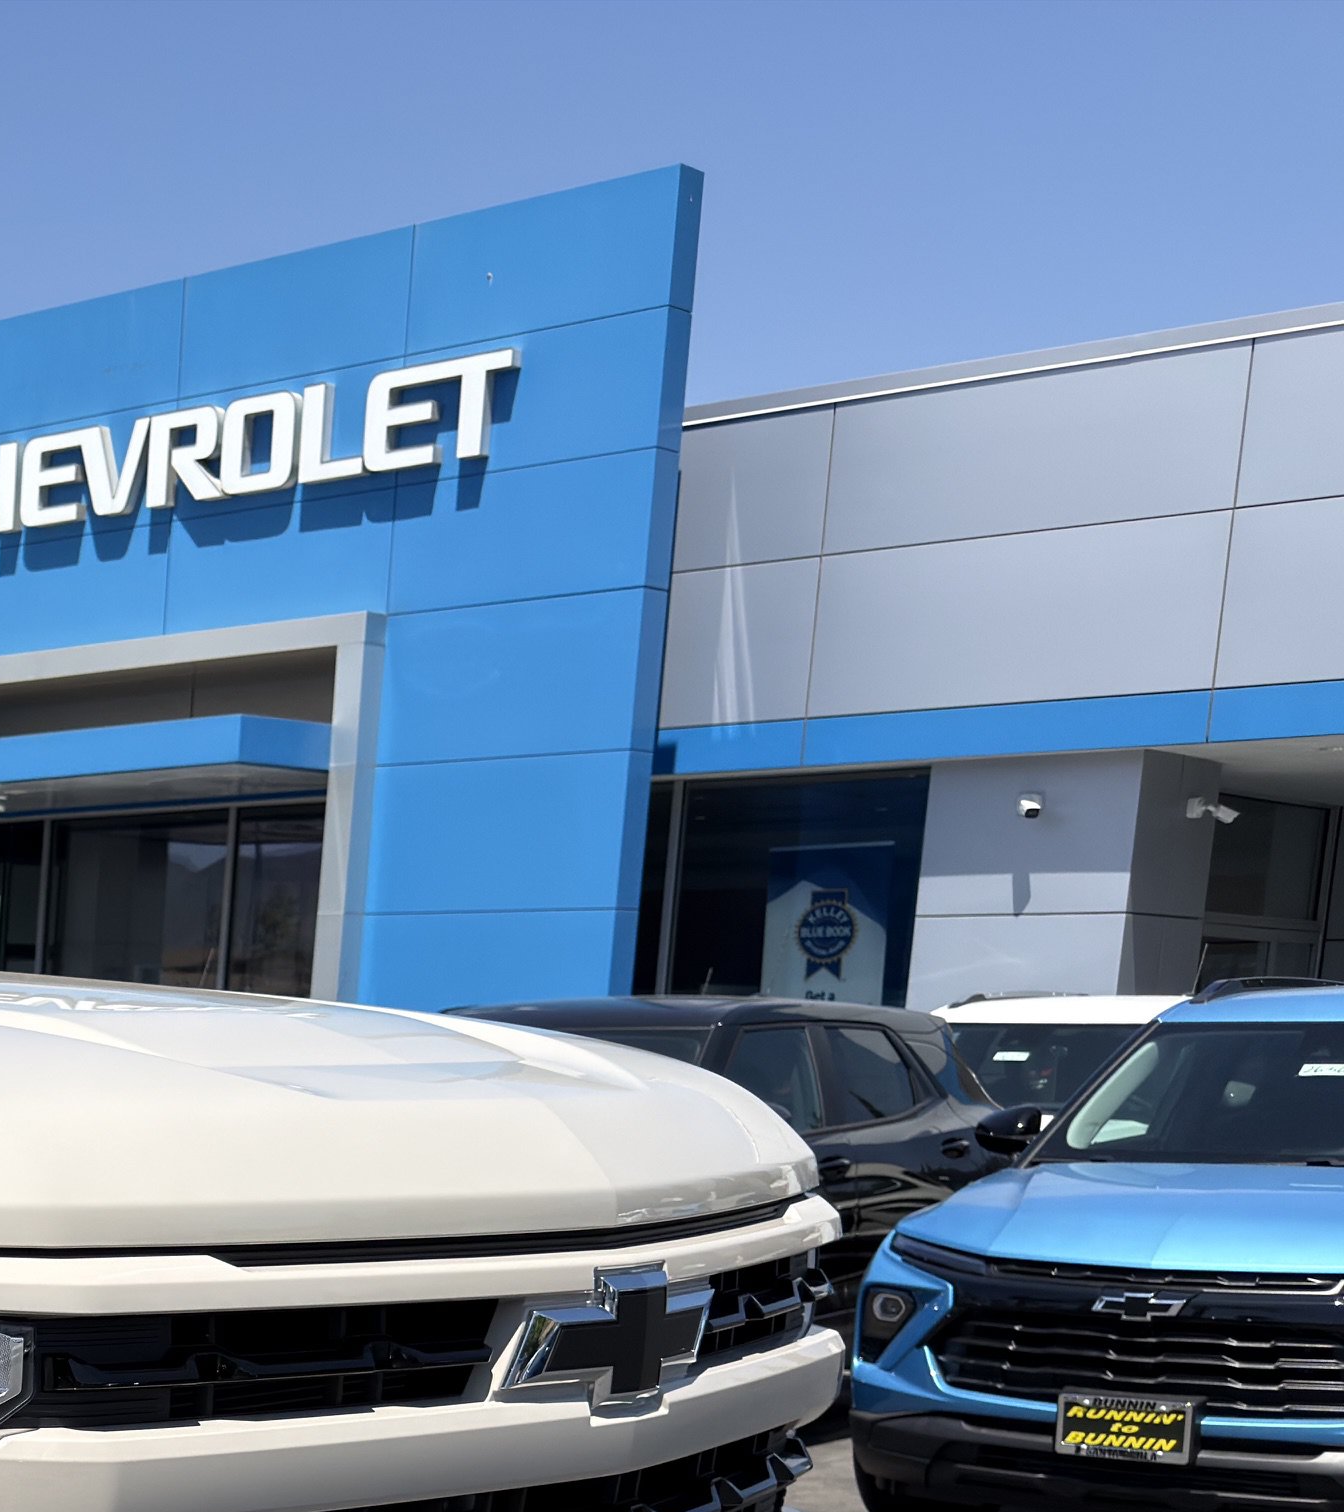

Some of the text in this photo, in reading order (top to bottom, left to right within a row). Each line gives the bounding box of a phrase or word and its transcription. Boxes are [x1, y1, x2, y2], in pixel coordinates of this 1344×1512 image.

[808, 906, 848, 923] KELLEY
[800, 926, 851, 938] BLUE BOOK
[1066, 1405, 1184, 1425] RUNNIN'
[1110, 1422, 1140, 1434] to
[1064, 1431, 1177, 1452] BUNNIN
